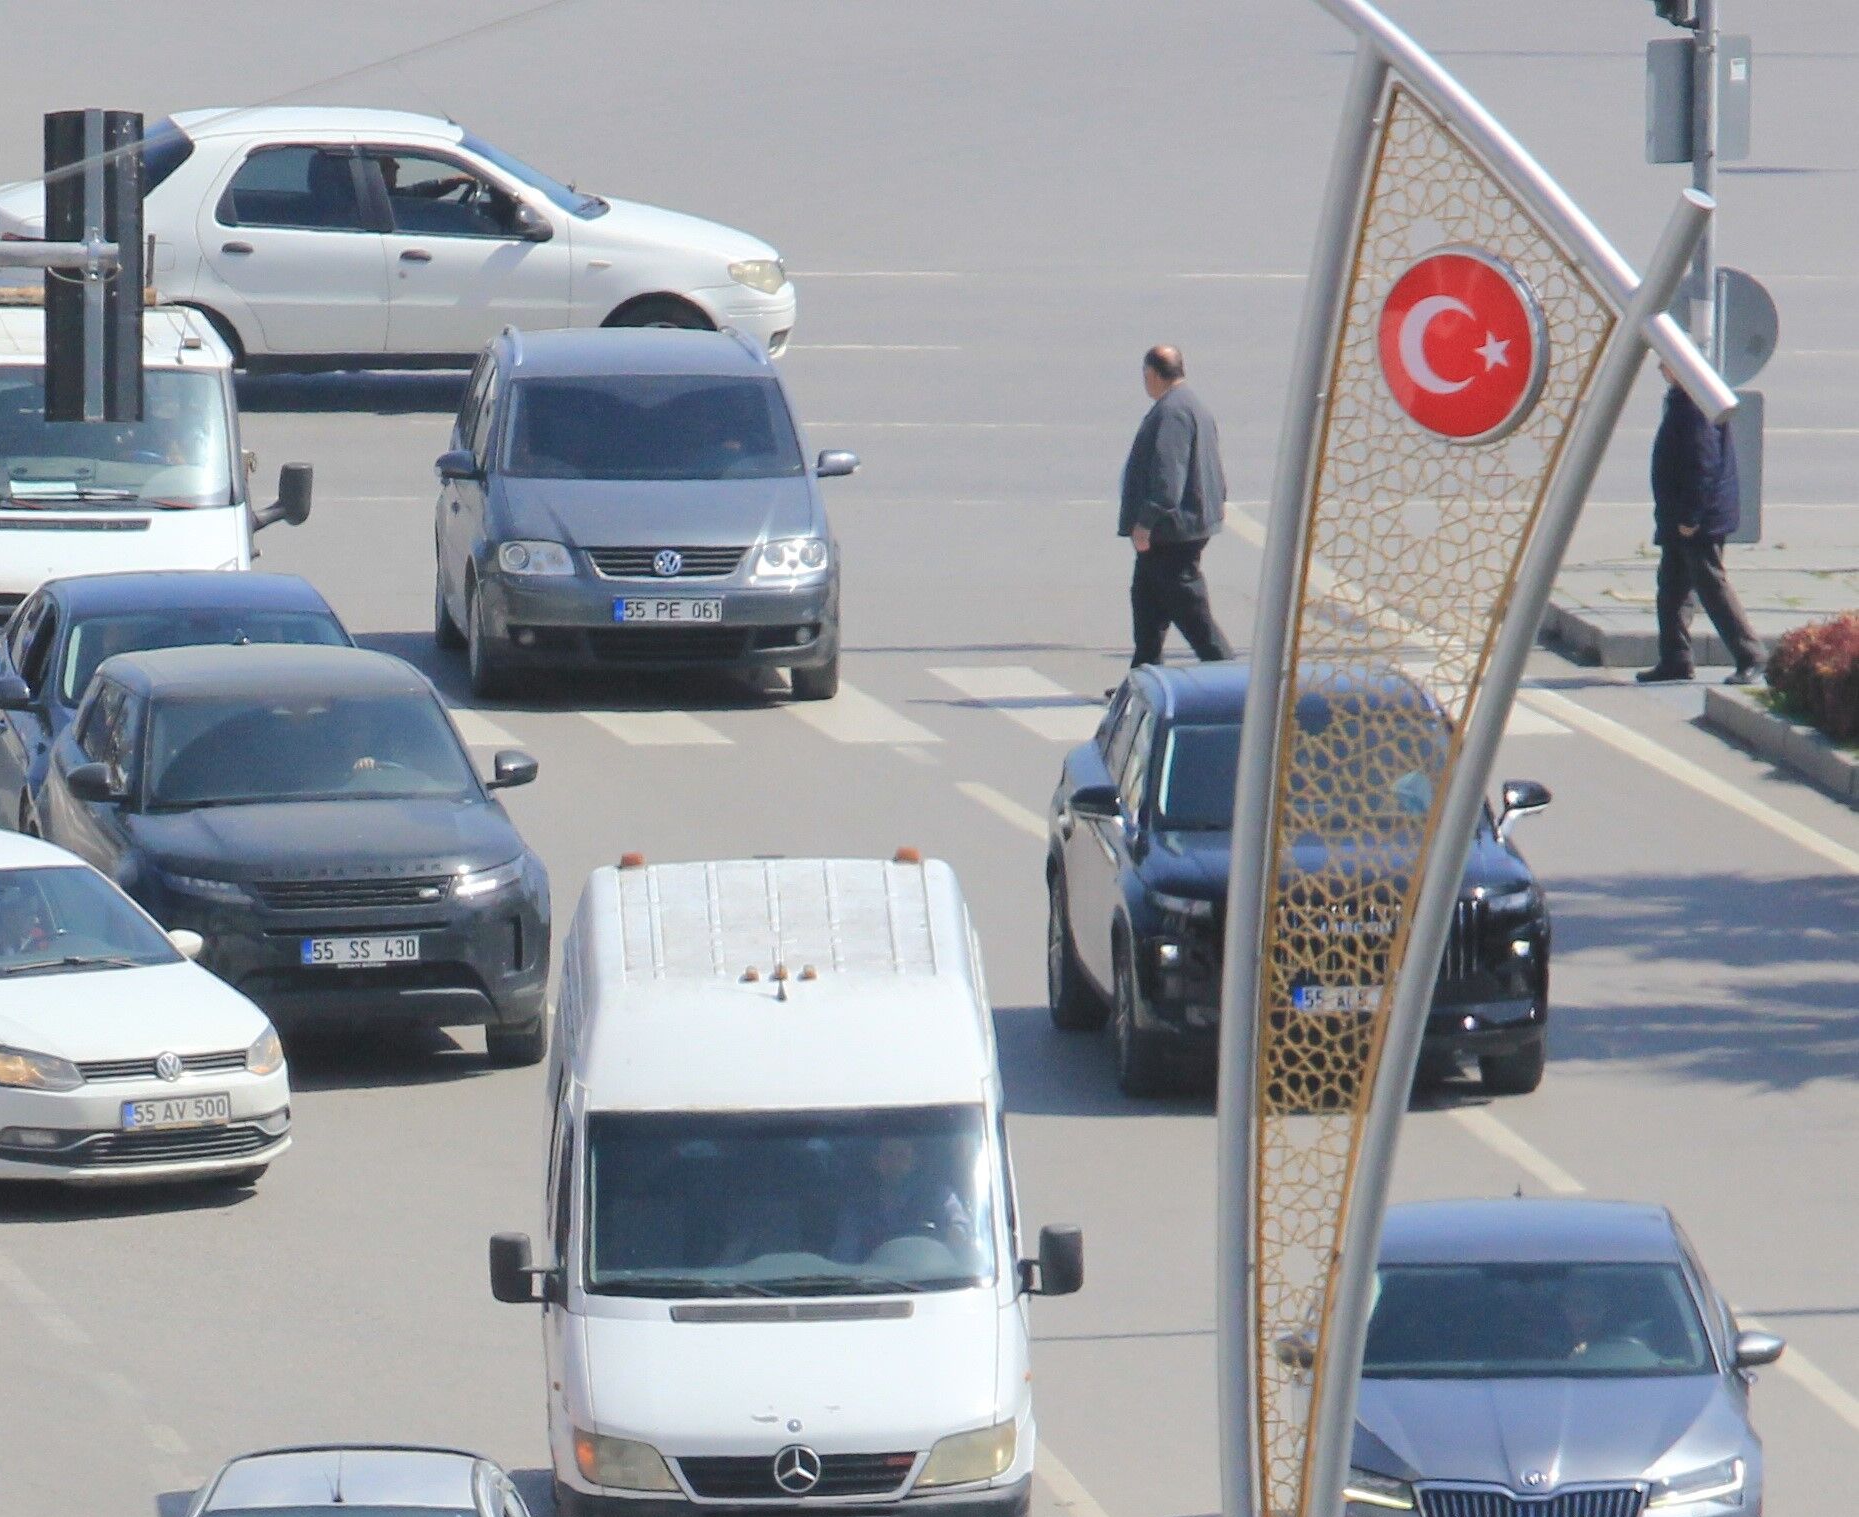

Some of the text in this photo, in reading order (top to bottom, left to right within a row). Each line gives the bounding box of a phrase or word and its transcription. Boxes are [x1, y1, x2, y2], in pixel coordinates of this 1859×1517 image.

[624, 601, 721, 619] 55 PE 061
[313, 939, 416, 960] 55 SS 430
[134, 1098, 226, 1123] 55 AV 500
